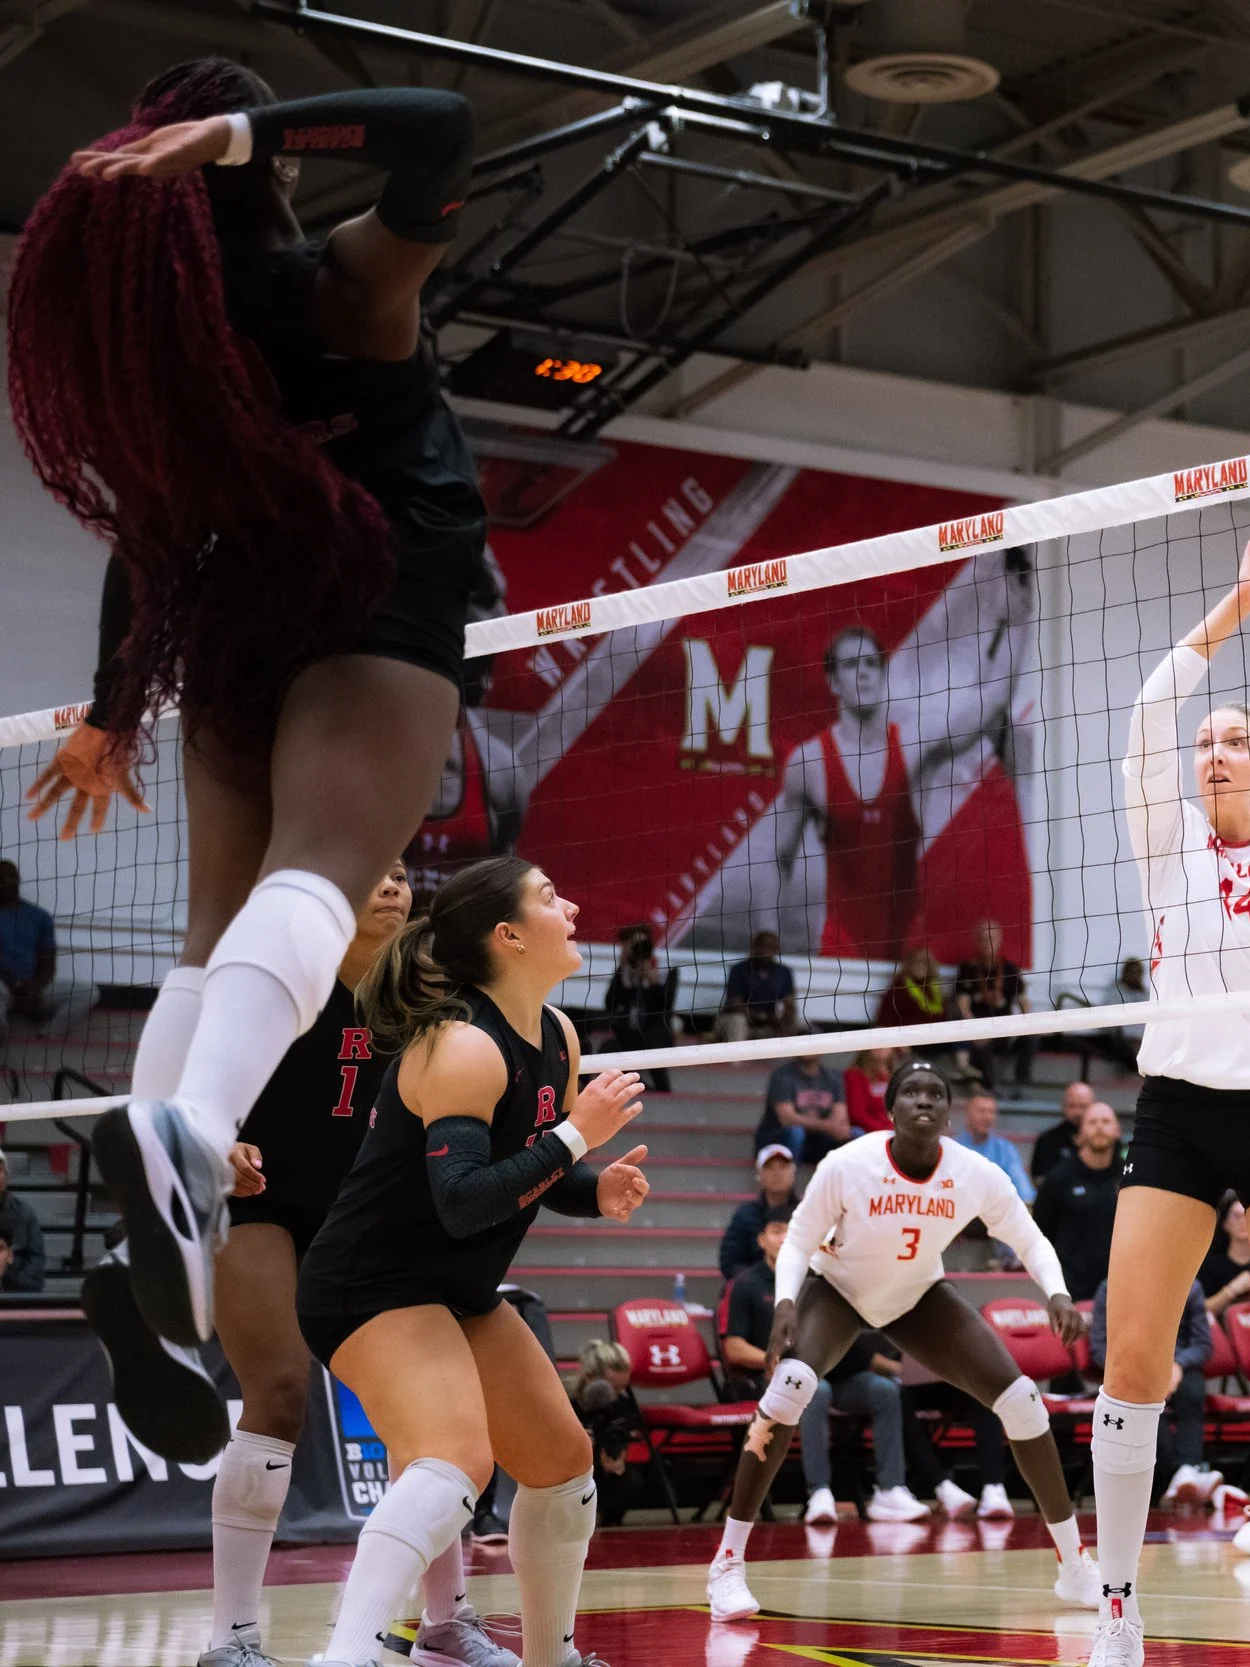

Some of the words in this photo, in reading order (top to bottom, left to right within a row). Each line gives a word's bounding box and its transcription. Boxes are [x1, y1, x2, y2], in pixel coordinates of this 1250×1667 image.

[1174, 458, 1248, 496] MARYLAND
[938, 512, 1004, 547] MARYLAND
[526, 477, 713, 687] WRSTLING
[727, 560, 788, 592] MARYLAND
[536, 602, 591, 630] MARYLAND
[54, 704, 92, 725] MARYLAN
[681, 637, 774, 757] M
[338, 1028, 372, 1060] R
[332, 1066, 358, 1117] 1
[534, 1085, 557, 1127] R
[518, 1167, 565, 1210] SCARLET
[869, 1194, 955, 1219] MARYLAND
[896, 1228, 921, 1260] 3
[0, 1400, 243, 1487] LEN
[348, 1461, 388, 1480] VOL
